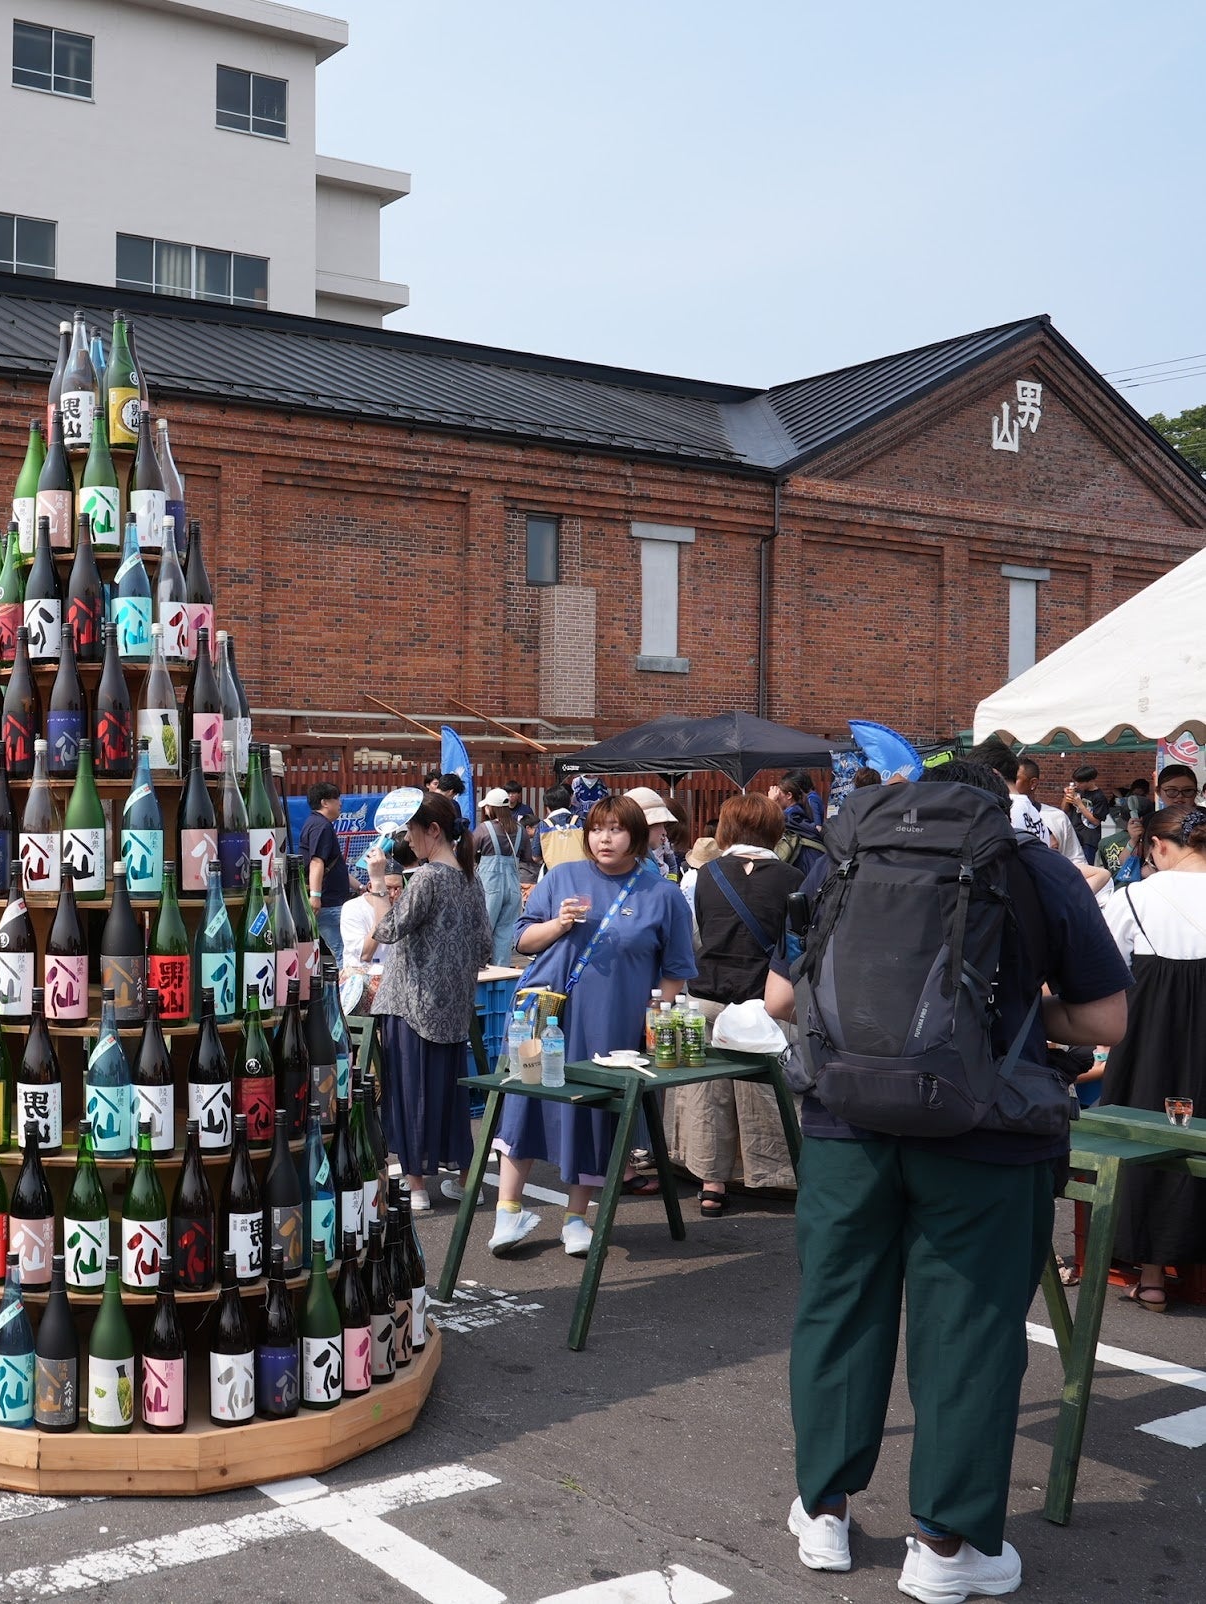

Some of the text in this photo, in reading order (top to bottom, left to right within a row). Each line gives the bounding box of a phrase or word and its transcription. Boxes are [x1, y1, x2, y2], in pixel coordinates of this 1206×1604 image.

[62, 397, 82, 439] 男山
[992, 380, 1042, 453] 男山
[83, 489, 115, 542] 八仙
[68, 597, 93, 655] 八仙
[114, 600, 149, 653] 八仙
[2, 714, 30, 771] 八仙
[55, 731, 79, 767] 八仙
[97, 712, 128, 769] 八仙
[895, 825, 924, 833] deuter
[20, 836, 51, 889] 八仙
[121, 832, 155, 889] 八仙
[46, 958, 80, 1017] 八仙
[159, 961, 185, 1014] 男山
[919, 1008, 928, 1019] PRO
[914, 1018, 925, 1039] FUTURA
[87, 1088, 122, 1149] 八仙
[248, 1097, 272, 1136] 八仙
[11, 1223, 45, 1280] 八仙
[67, 1223, 102, 1284] 八仙
[127, 1224, 163, 1285] 八仙
[178, 1222, 211, 1283] 八仙
[144, 1359, 170, 1420] 八仙
[164, 1361, 176, 1381] 陸奥
[217, 1366, 254, 1418] 八仙
[313, 1340, 343, 1400] 八仙
